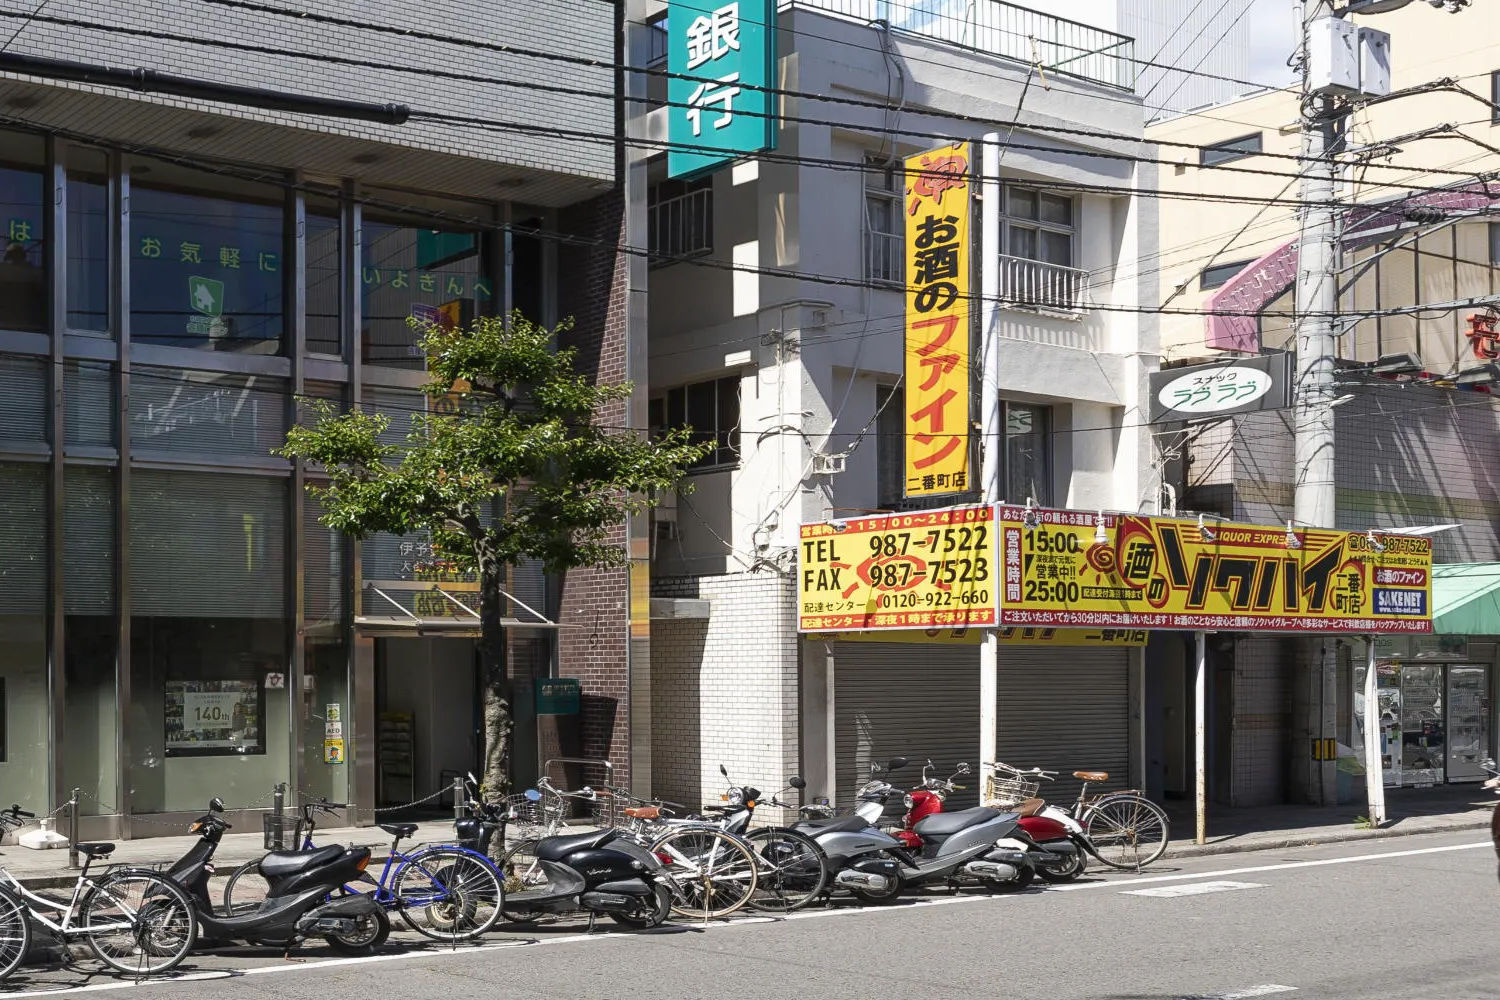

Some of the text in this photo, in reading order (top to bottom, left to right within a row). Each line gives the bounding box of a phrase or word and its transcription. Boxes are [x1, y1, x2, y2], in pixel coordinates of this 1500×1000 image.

[141, 237, 277, 272] お気軽に
[910, 214, 962, 470] お酒のファイン
[1193, 372, 1237, 385] スナック
[907, 471, 967, 492] 二番町店
[804, 526, 988, 563] TEL 987-7522
[1025, 530, 1079, 553] 15:00
[1253, 534, 1296, 546] EXPRE
[804, 558, 988, 592] FAX 987-7523
[1006, 530, 1021, 601] 営業時間
[1377, 569, 1424, 584] お酒のファイン
[804, 590, 988, 613] 配達センター 0120-922-660
[1025, 581, 1079, 603] 25:00
